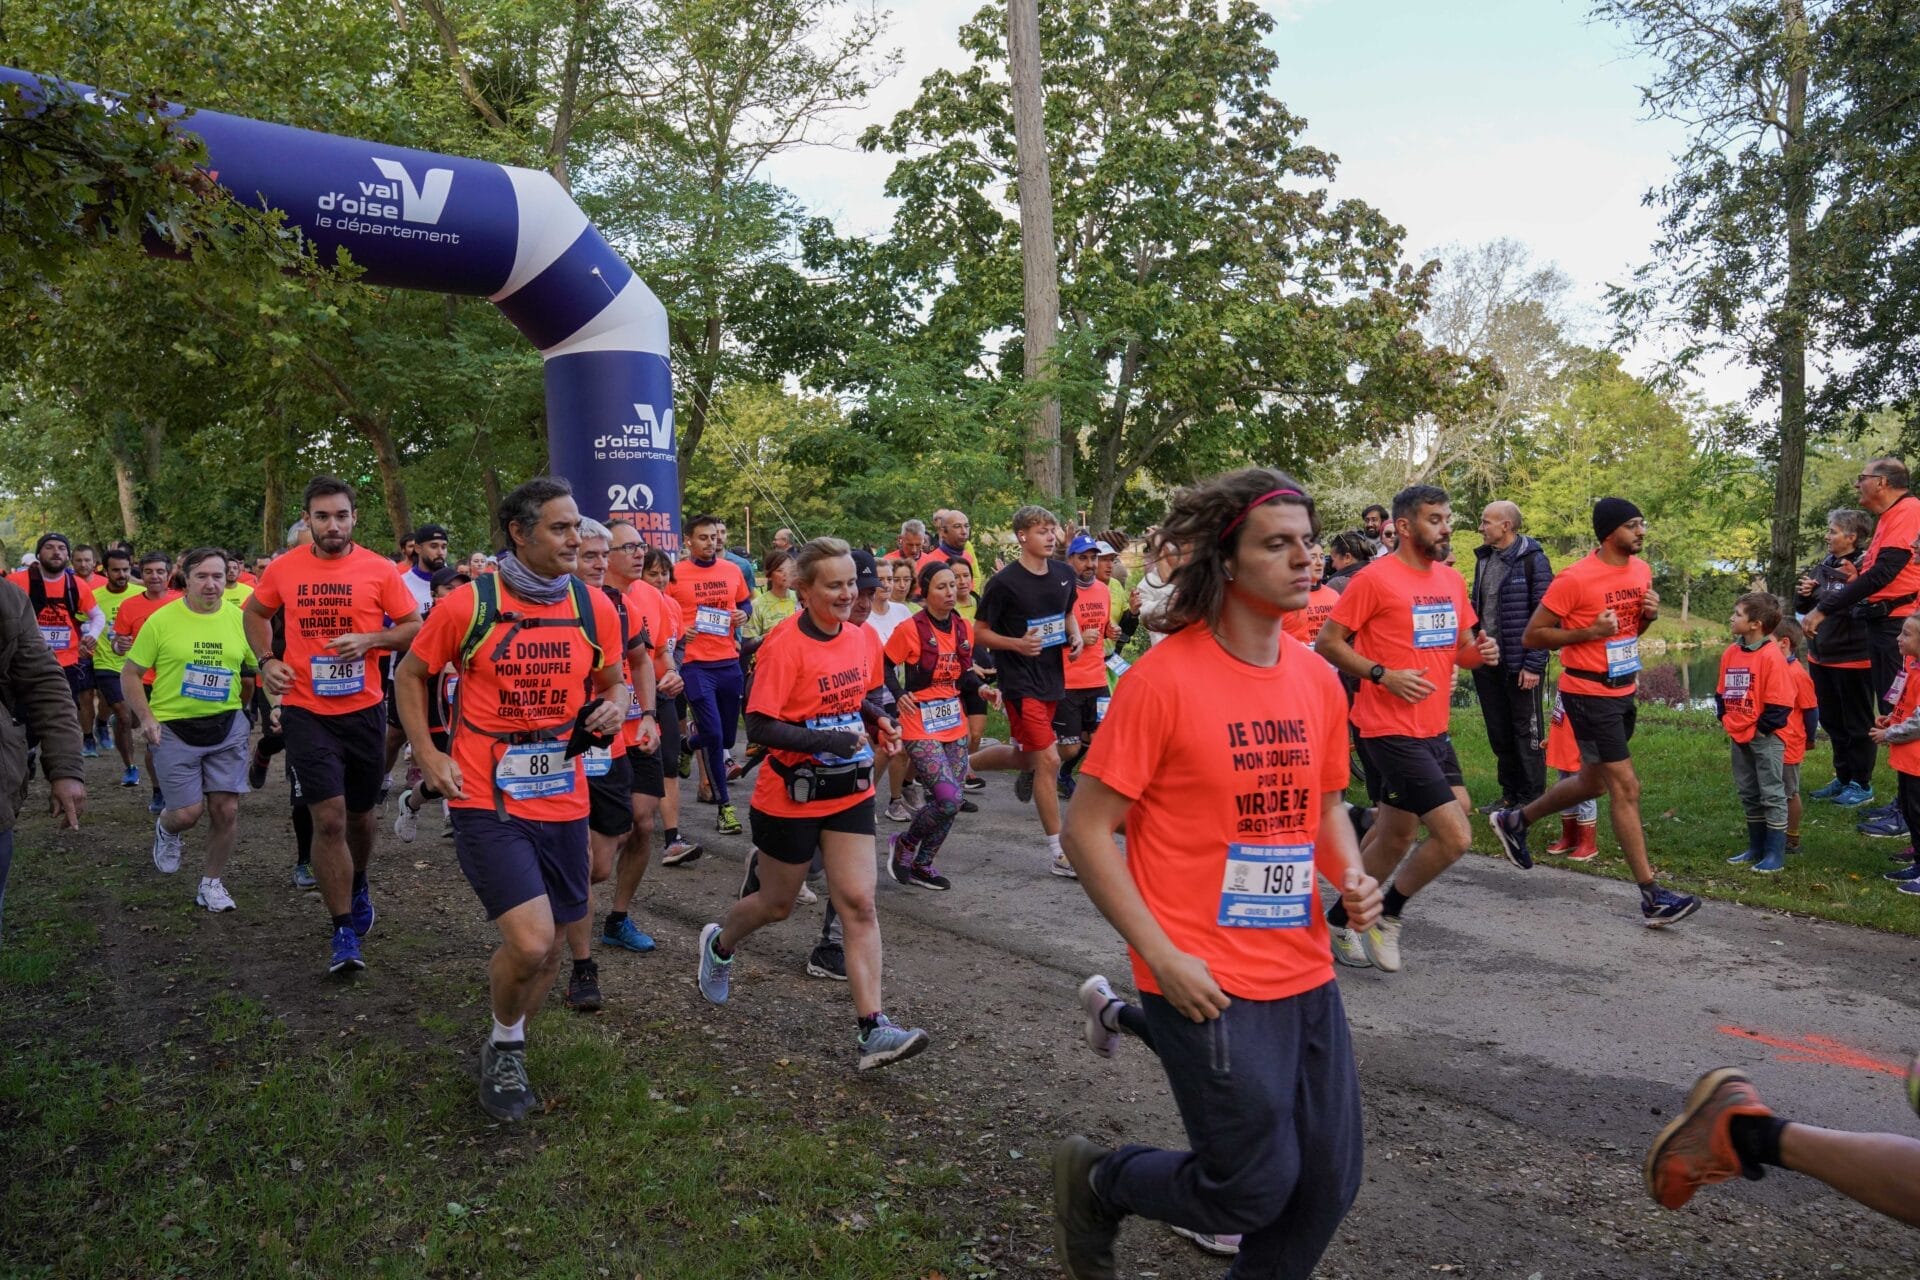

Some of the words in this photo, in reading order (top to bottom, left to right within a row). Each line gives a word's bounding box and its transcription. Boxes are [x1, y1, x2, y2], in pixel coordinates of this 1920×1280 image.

[358, 181, 398, 200] val
[317, 191, 399, 219] d'oise
[315, 213, 332, 228] le
[336, 217, 460, 245] département
[622, 421, 649, 435] val
[594, 434, 650, 448] d'oise
[594, 450, 606, 460] le
[297, 584, 308, 596] JE
[312, 583, 352, 596] DONNE
[703, 581, 727, 590] DONNE
[297, 598, 316, 607] MON
[318, 597, 352, 607] SOUFFLE
[1605, 592, 1614, 604] JE
[1615, 586, 1642, 601] DONNE
[311, 608, 329, 616] POUR
[331, 608, 339, 616] LA
[709, 613, 721, 625] 138
[299, 616, 337, 628] VIRADE
[339, 616, 352, 627] DE
[1431, 613, 1446, 629] 133
[50, 631, 60, 640] 97
[193, 641, 200, 649] JE
[202, 641, 223, 650] DONNE
[496, 643, 511, 660] E
[516, 641, 571, 660] DONNE
[329, 663, 353, 679] 246
[495, 663, 522, 677] MON
[525, 662, 571, 676] SOUFFLE
[203, 673, 219, 687] 191
[514, 678, 539, 688] POUR
[541, 678, 551, 688] LA
[817, 675, 831, 694] JE
[831, 667, 861, 689] DONNE
[498, 689, 547, 707] VIRADE
[551, 689, 568, 704] DE
[821, 693, 839, 706] MON
[498, 705, 565, 718] CERGY-PONTOISE
[935, 704, 952, 718] 268
[1227, 722, 1249, 748] JE
[1251, 719, 1307, 745] DONNE
[530, 754, 549, 776] 88
[1232, 751, 1264, 772] MON
[1266, 748, 1310, 768] SOUFFLE
[1281, 772, 1293, 786] LA
[1263, 864, 1294, 894] 198
